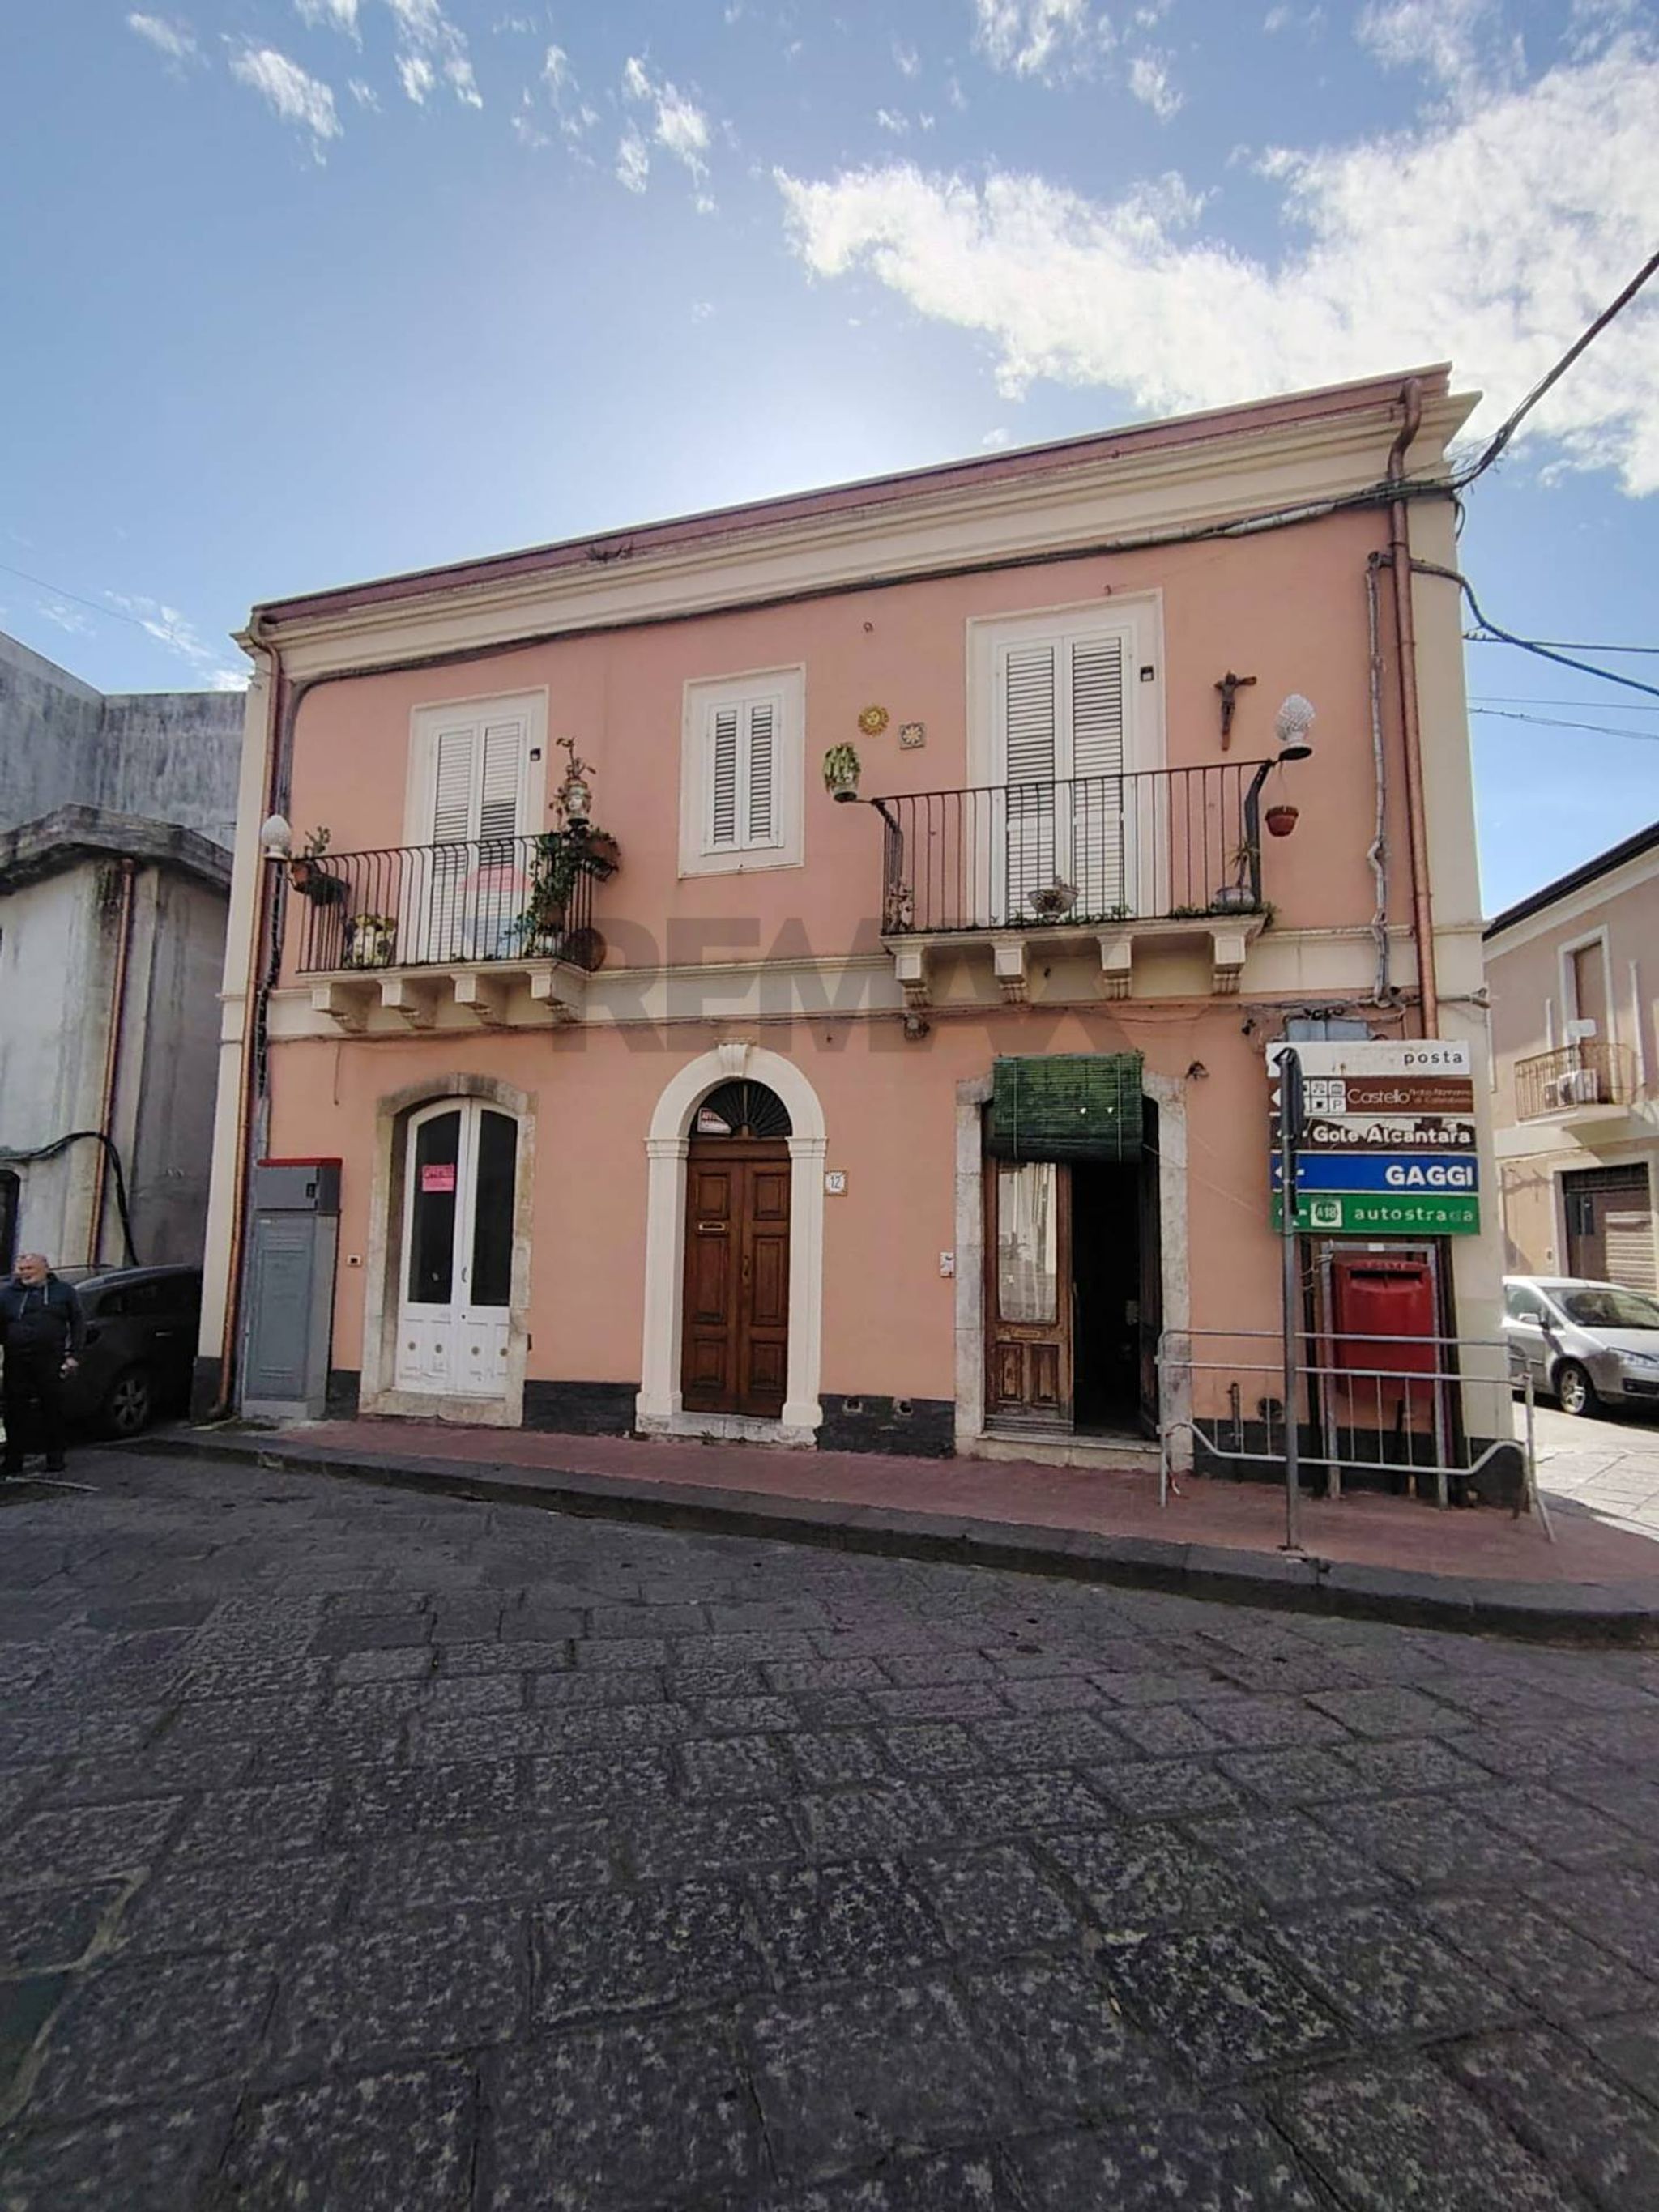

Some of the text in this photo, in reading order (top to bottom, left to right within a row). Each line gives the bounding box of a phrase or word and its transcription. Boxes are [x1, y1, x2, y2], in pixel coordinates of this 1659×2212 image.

[1403, 1051, 1463, 1066] posta
[1312, 1126, 1471, 1144] Gole Alcantara
[1385, 1165, 1473, 1186] GAGGI
[1316, 1206, 1337, 1218] A18
